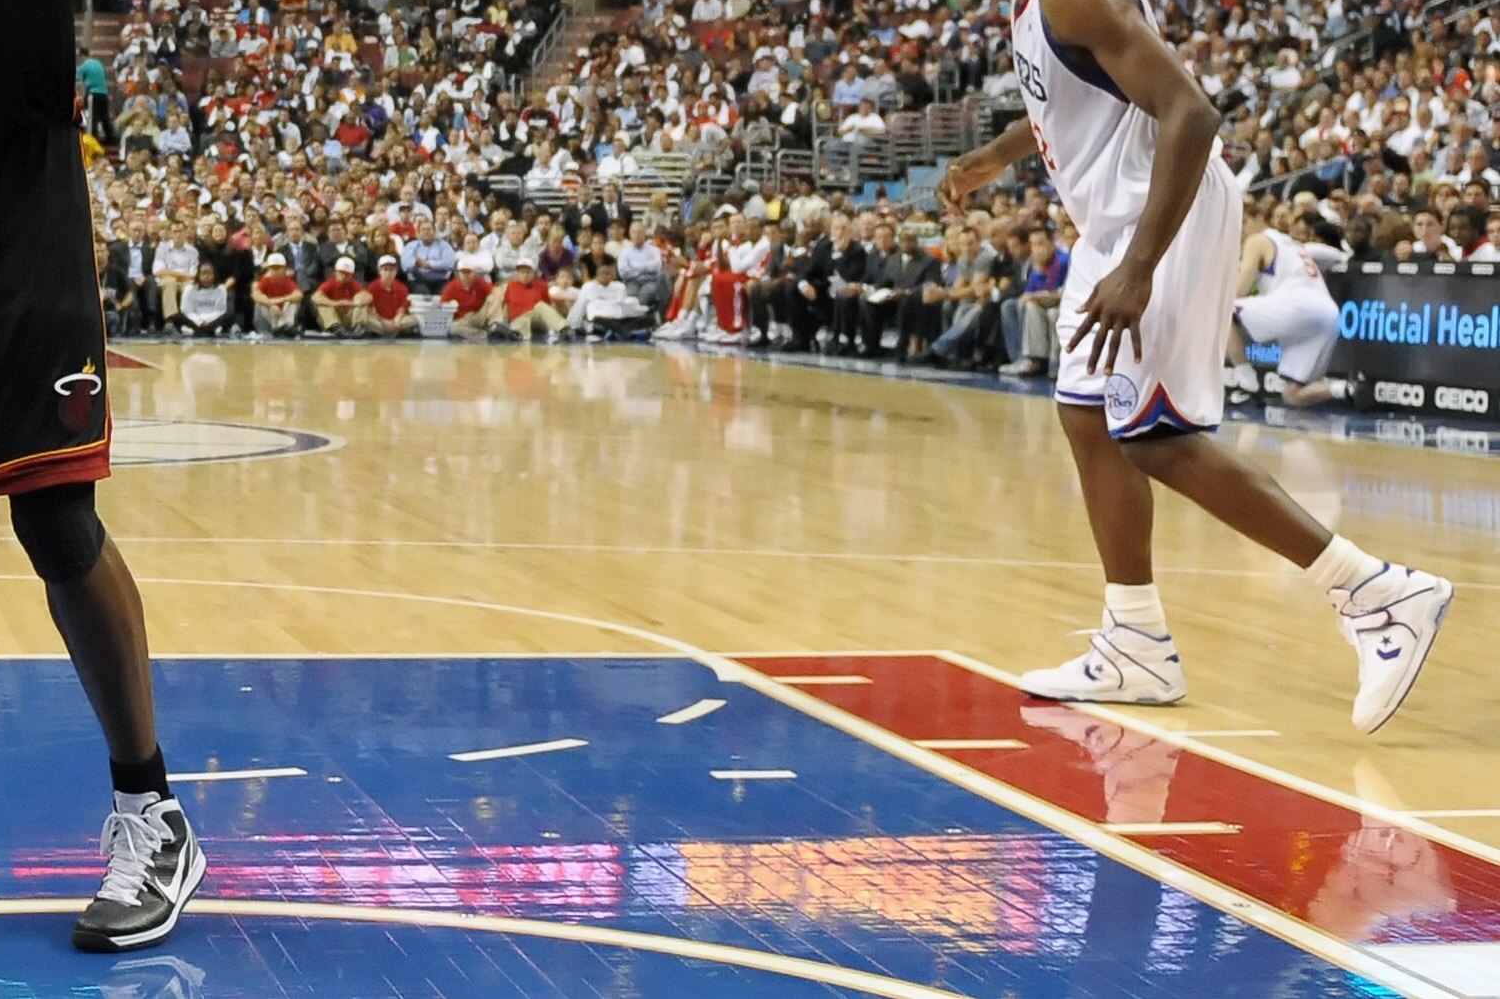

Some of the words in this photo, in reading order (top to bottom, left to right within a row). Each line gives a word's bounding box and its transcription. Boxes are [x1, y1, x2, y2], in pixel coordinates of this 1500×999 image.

[1339, 299, 1431, 346] Official
[1436, 303, 1500, 349] Heal
[1374, 381, 1425, 407] GEICO
[1434, 386, 1489, 414] GEICO
